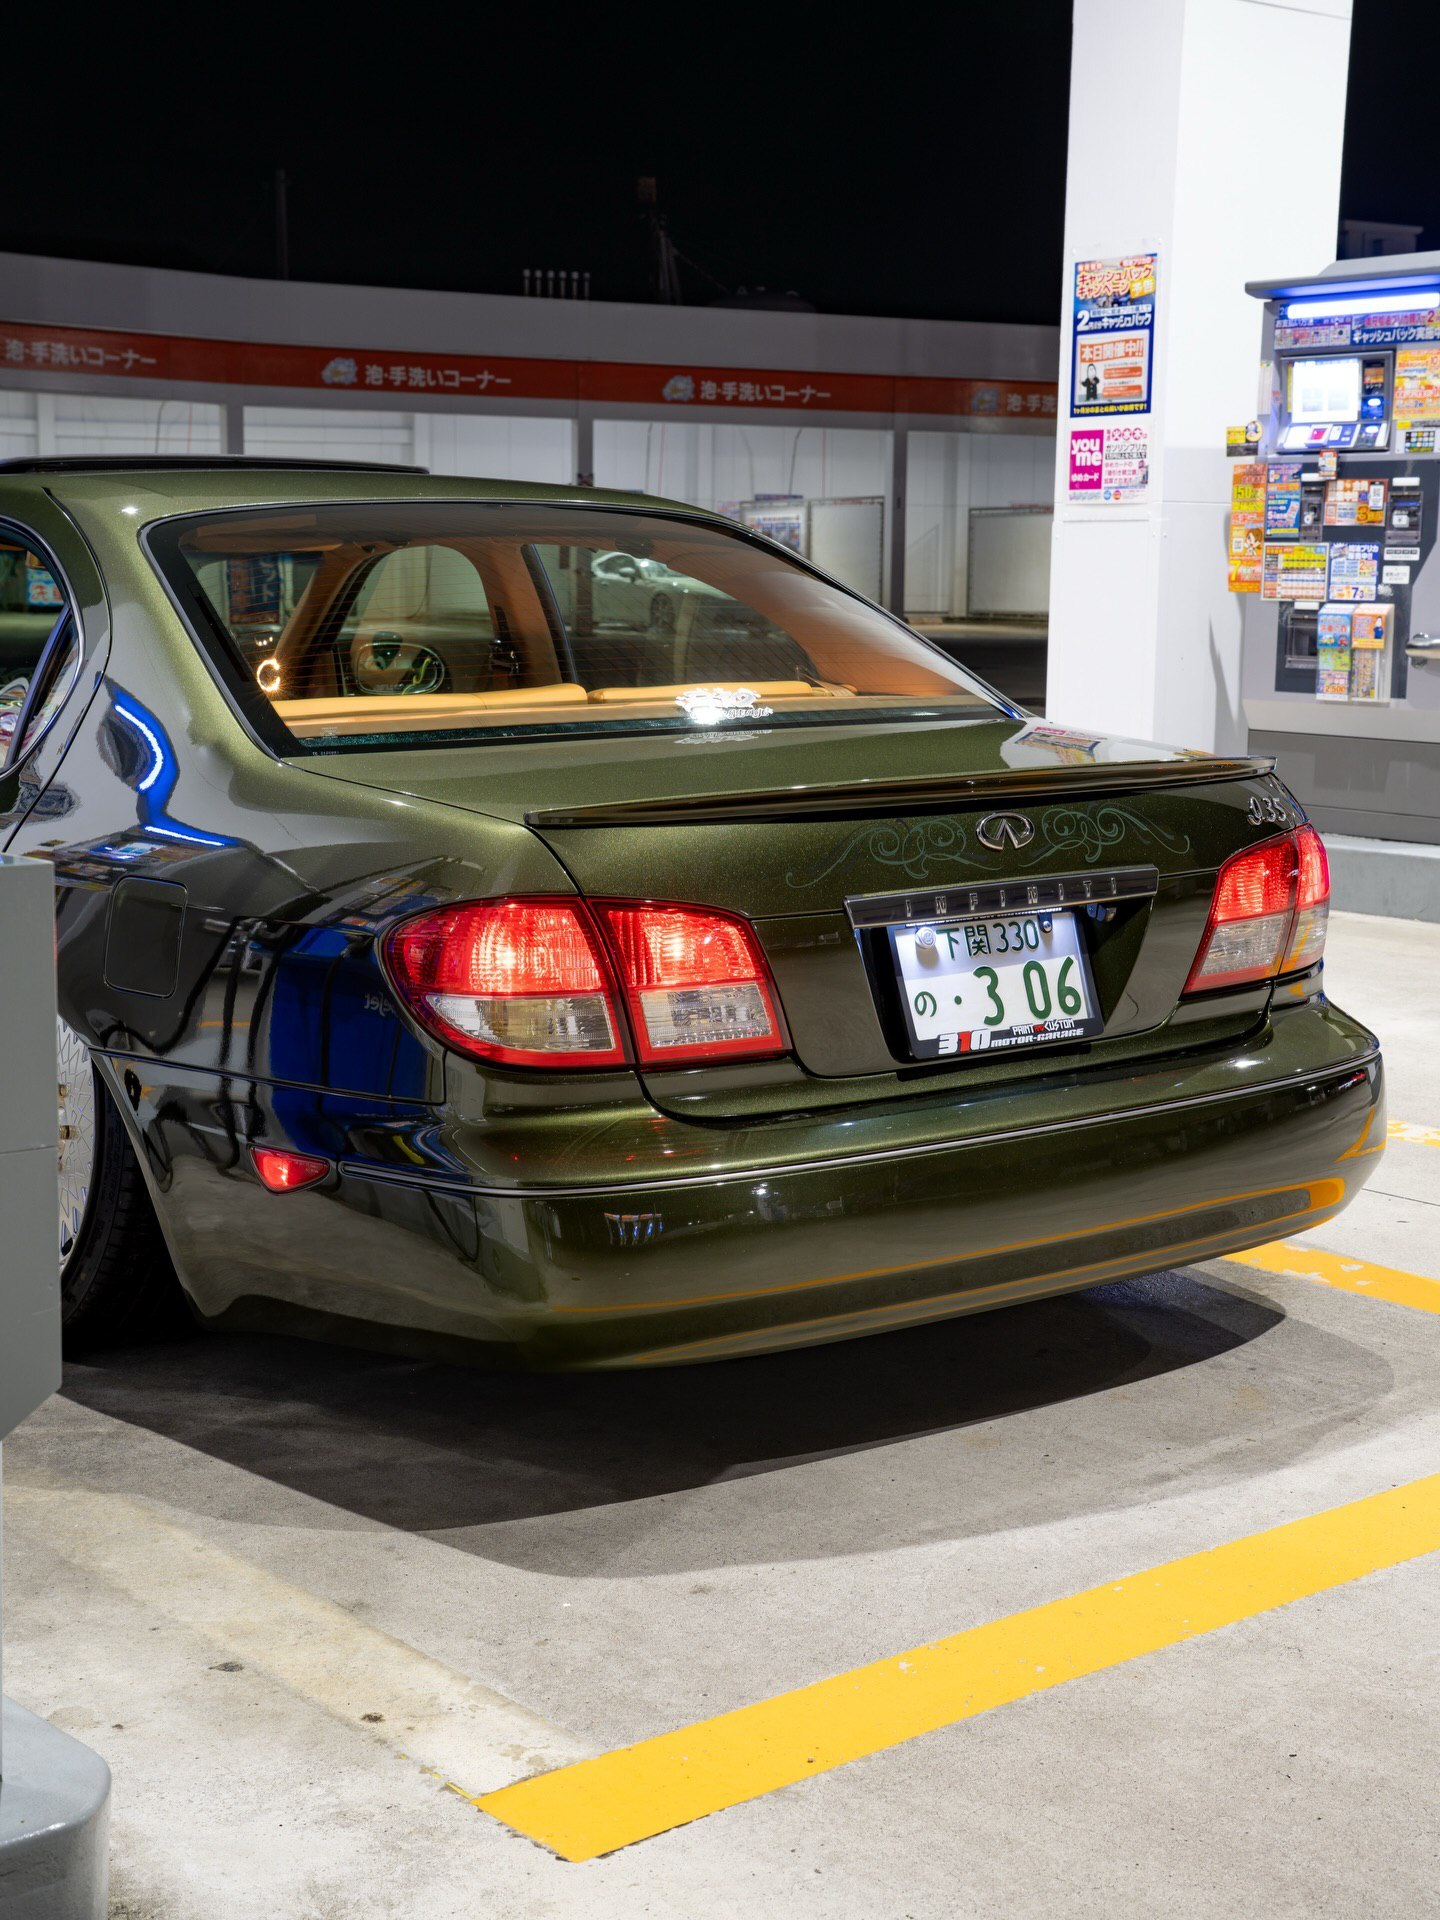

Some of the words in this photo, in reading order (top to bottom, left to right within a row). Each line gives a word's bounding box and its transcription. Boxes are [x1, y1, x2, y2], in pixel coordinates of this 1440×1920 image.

[1077, 265, 1153, 285] キャッシュバック
[1072, 438, 1100, 455] you
[1075, 451, 1102, 467] me
[904, 876, 1117, 918] INFINITI
[914, 991, 938, 1017] の
[1012, 1024, 1034, 1036] PRINT
[1044, 1019, 1075, 1031] CUSTOM
[938, 1029, 991, 1055] 310
